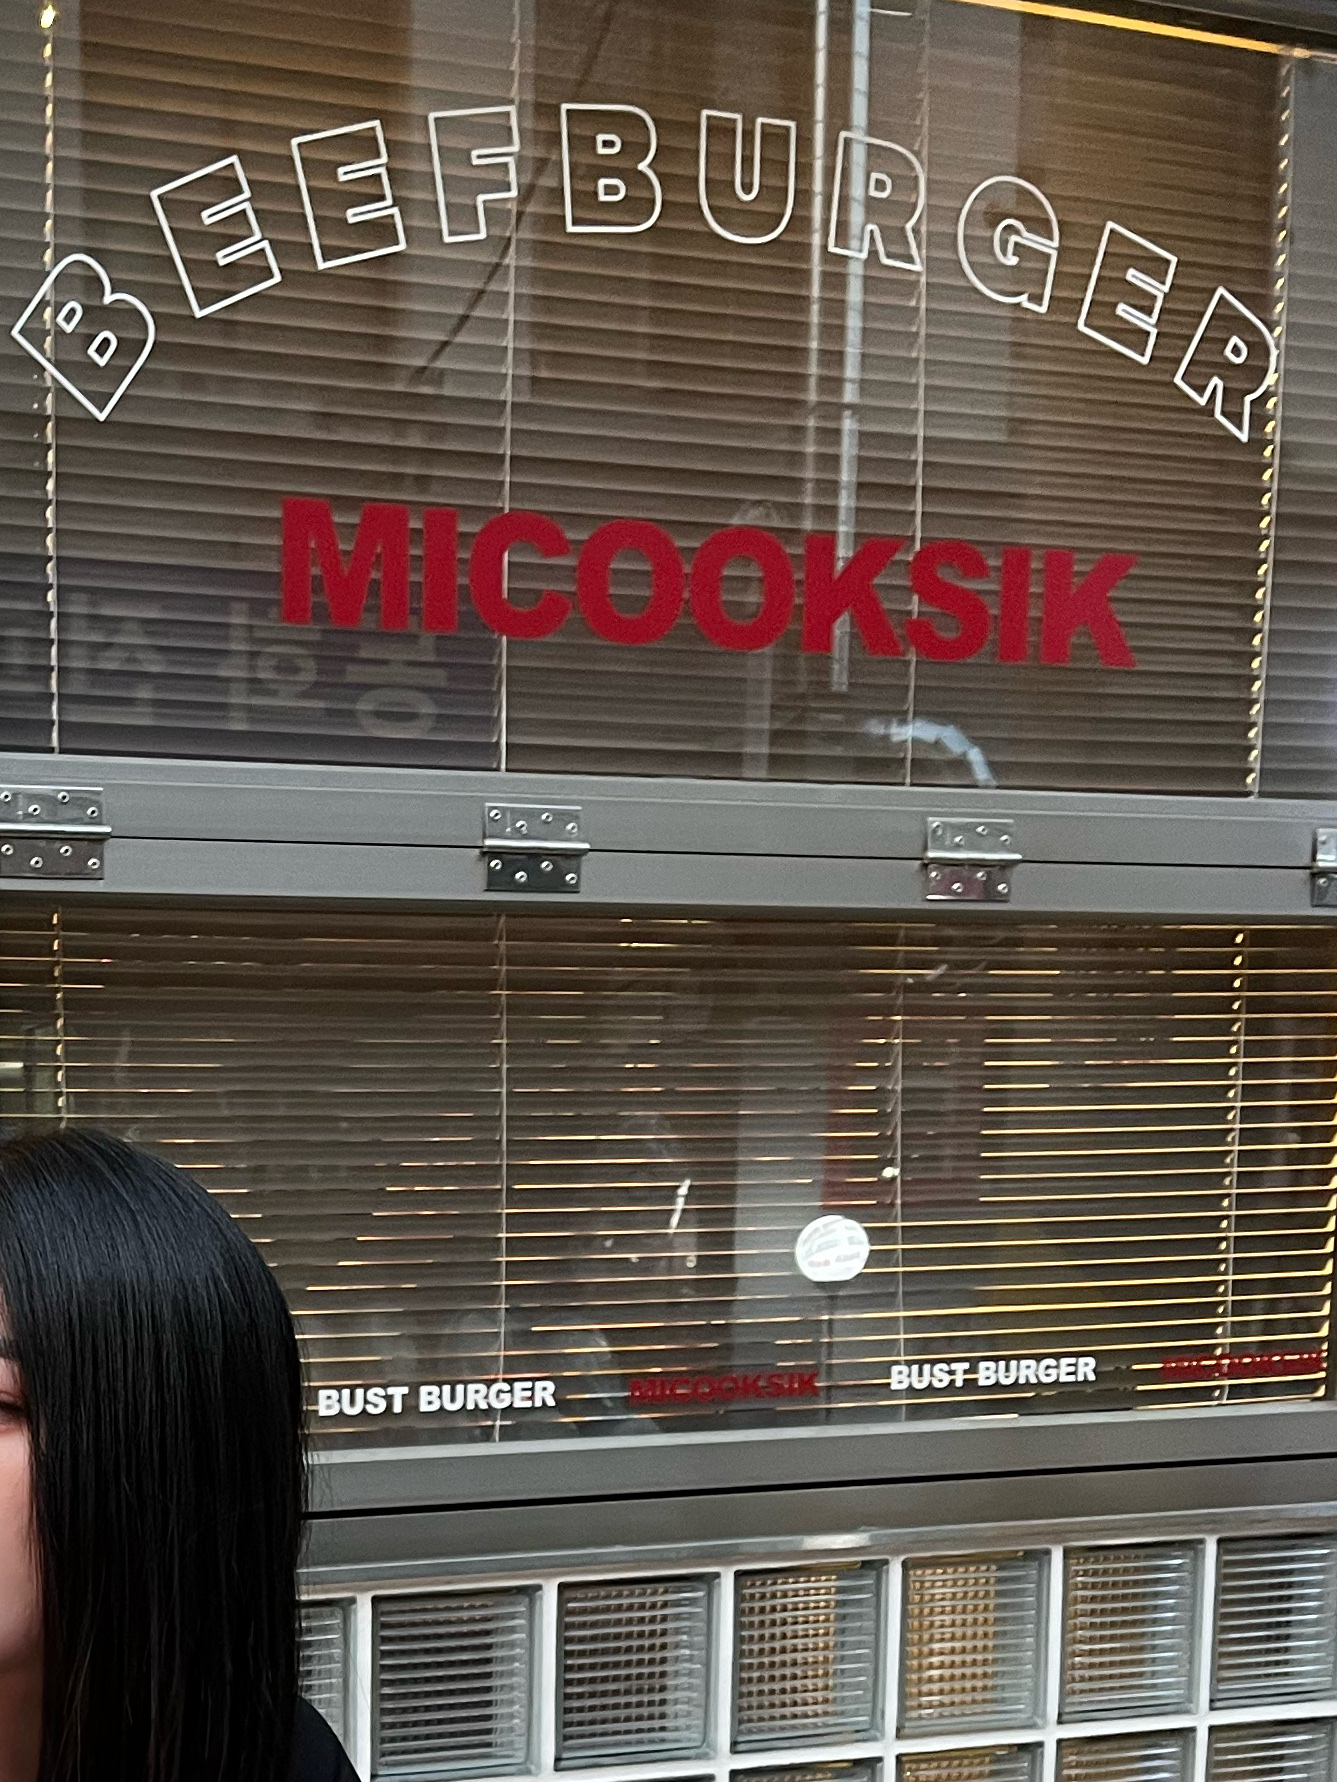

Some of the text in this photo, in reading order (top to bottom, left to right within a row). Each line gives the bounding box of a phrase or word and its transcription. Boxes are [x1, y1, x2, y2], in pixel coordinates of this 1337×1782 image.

[10, 102, 1280, 443] BEEFBURGER
[280, 497, 1138, 668] MICOOKSIK
[317, 1380, 557, 1417] BUST BURGER
[890, 1356, 1097, 1390] BUST BURGER
